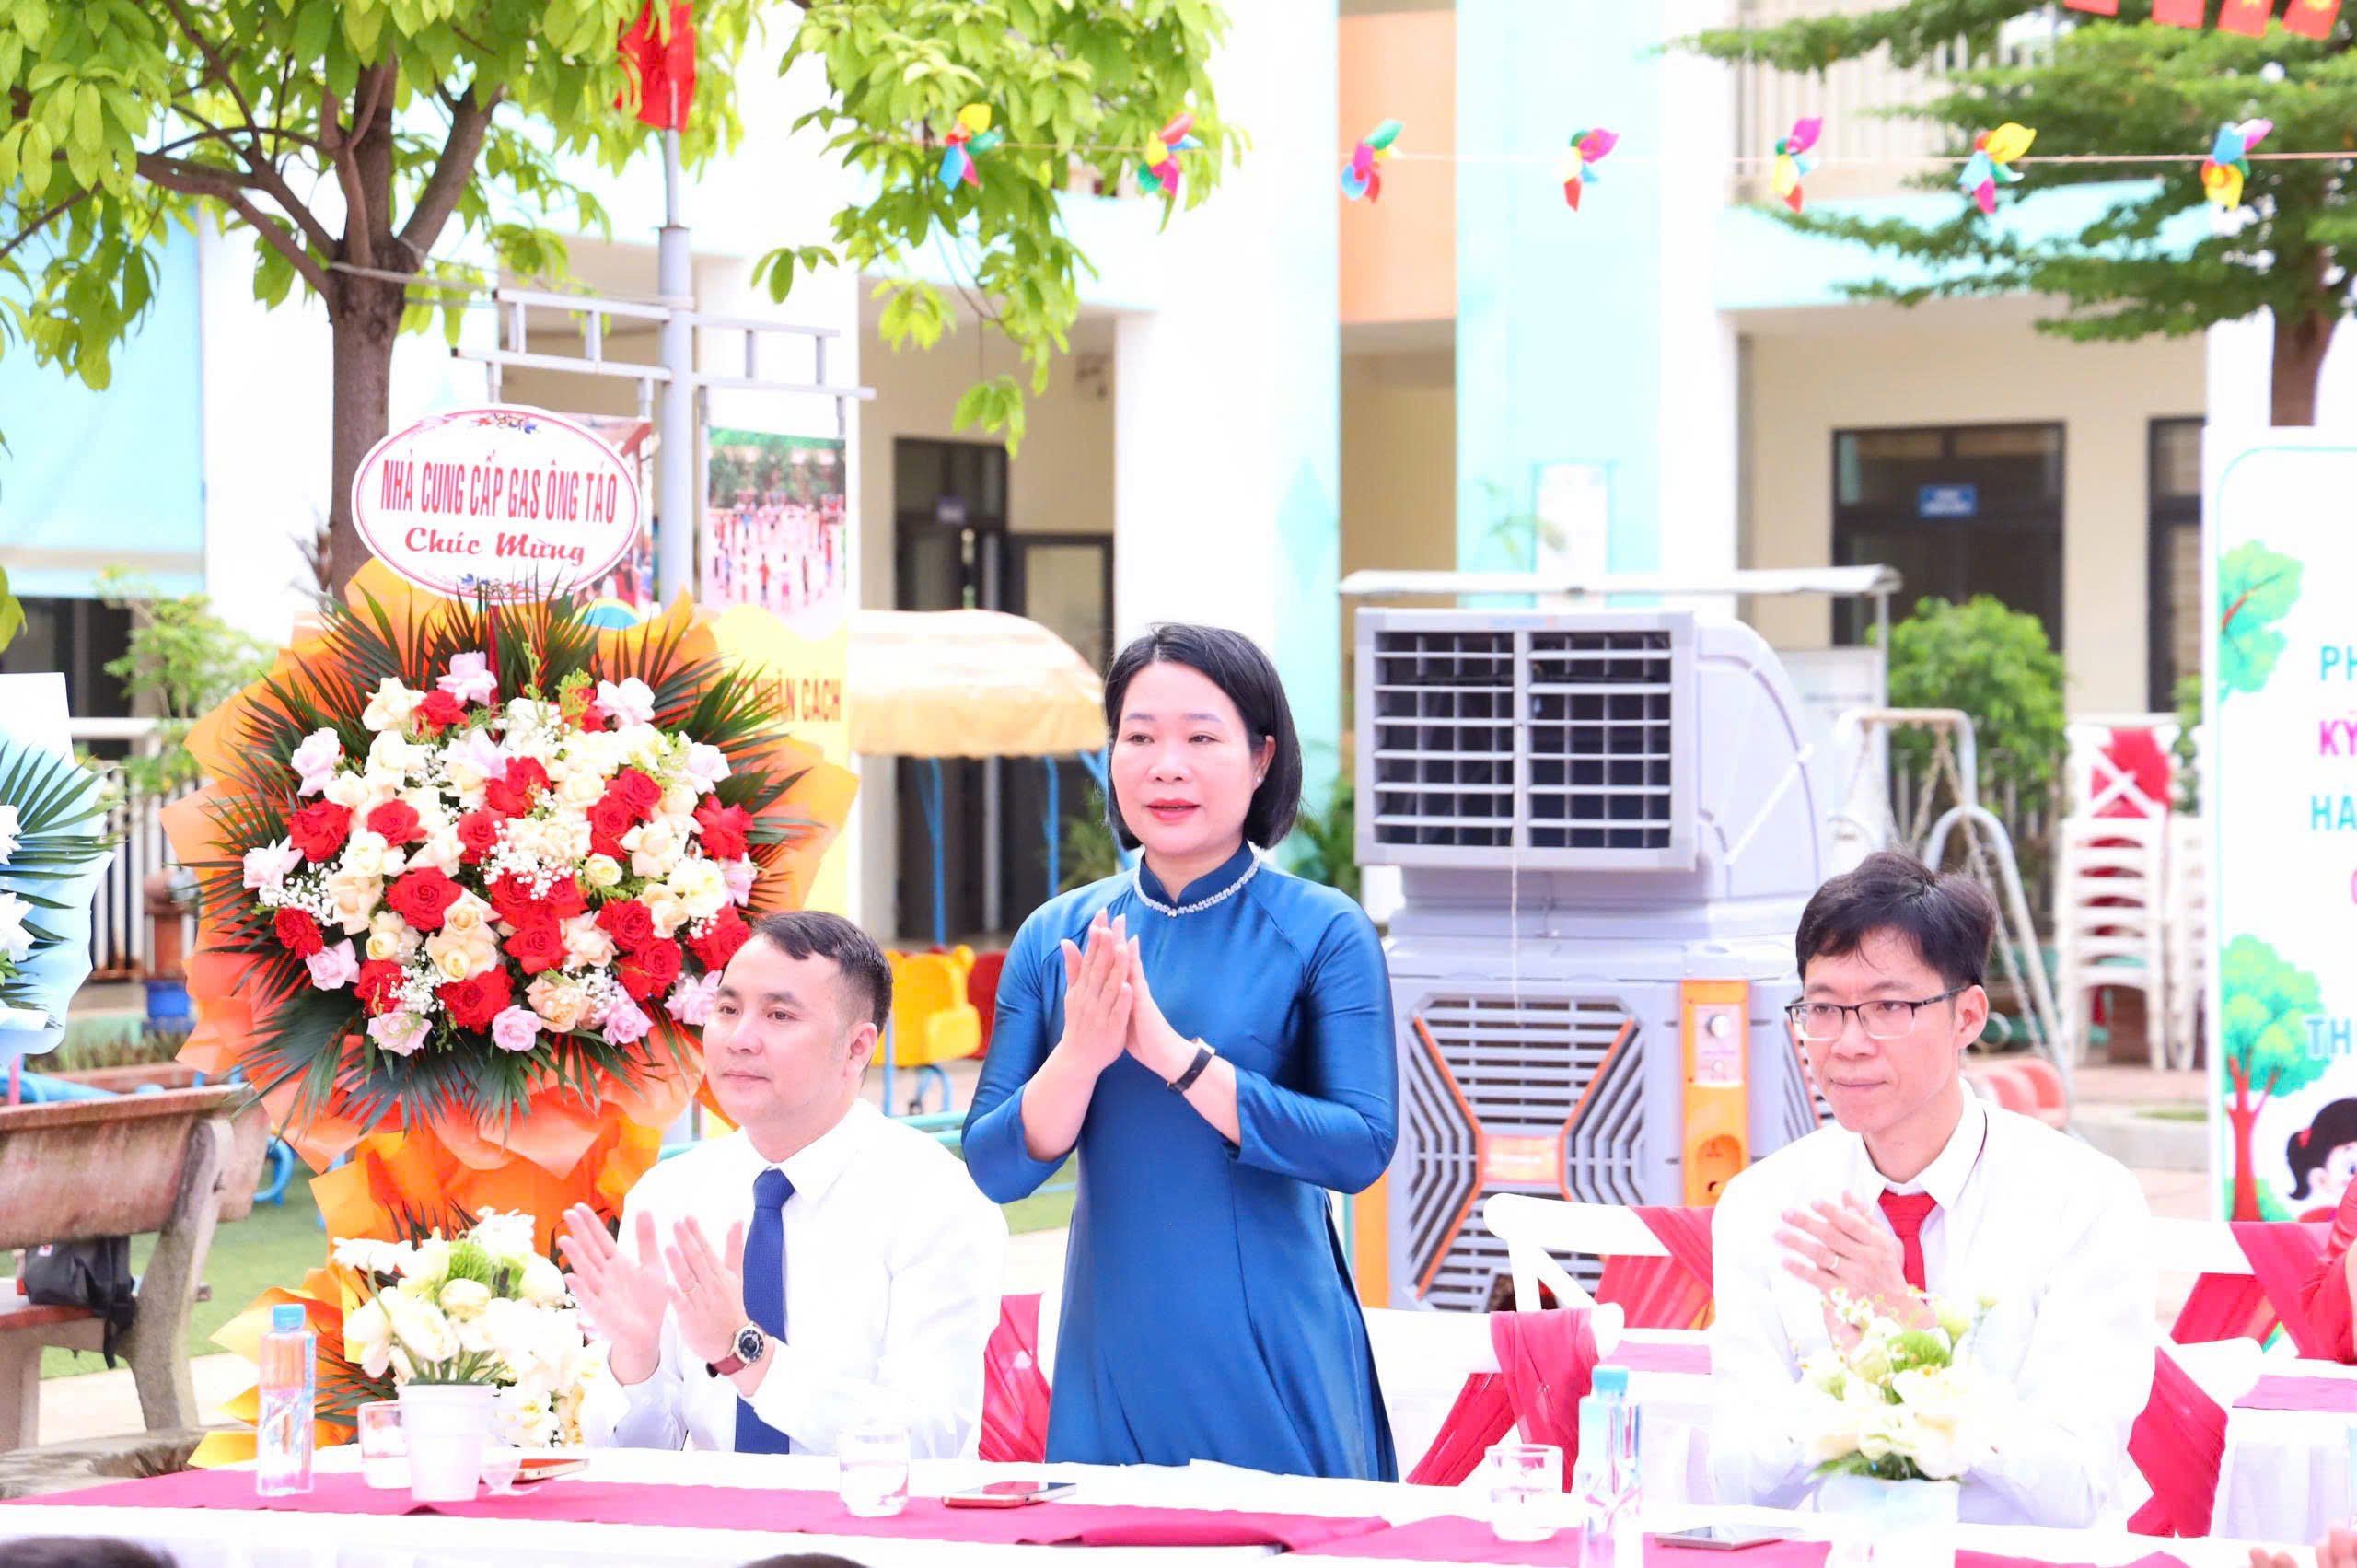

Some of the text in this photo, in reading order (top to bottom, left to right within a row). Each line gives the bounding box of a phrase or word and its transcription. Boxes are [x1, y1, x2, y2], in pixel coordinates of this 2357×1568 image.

[381, 449, 618, 523] NHÀ CUNG CẤP GAS ÔNG TÁO
[405, 527, 585, 566] Chúc Mừng
